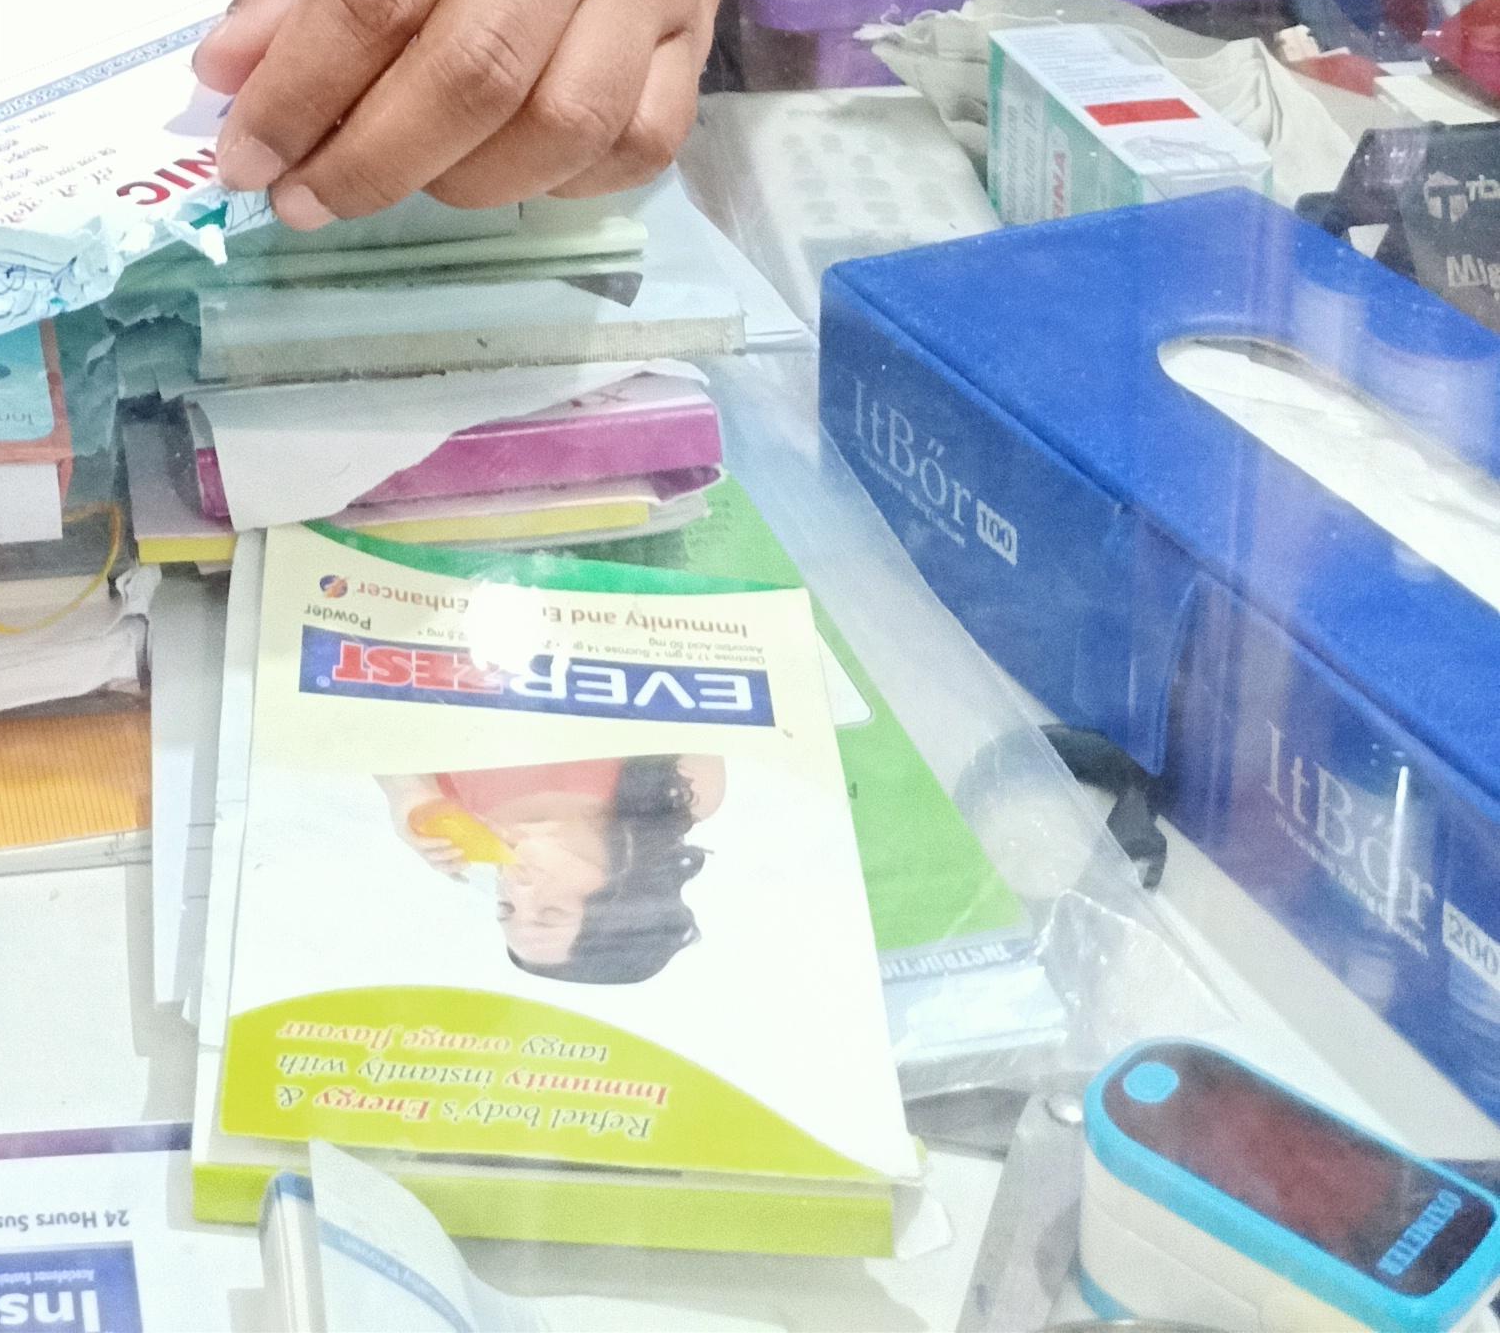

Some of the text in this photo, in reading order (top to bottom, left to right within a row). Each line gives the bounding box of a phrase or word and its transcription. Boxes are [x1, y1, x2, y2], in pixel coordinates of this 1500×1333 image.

[357, 582, 469, 614] Enhancer
[304, 603, 372, 631] Powder
[571, 608, 617, 625] and
[625, 609, 748, 638] Immunity
[280, 1021, 608, 1062] tangy orange flavour
[278, 1053, 668, 1106] Immunity instantly with
[279, 1086, 304, 1108] &
[315, 1087, 430, 1120] Energy
[552, 1108, 652, 1138] Refuel
[36, 1211, 97, 1229] Hours
[104, 1209, 130, 1228] 24
